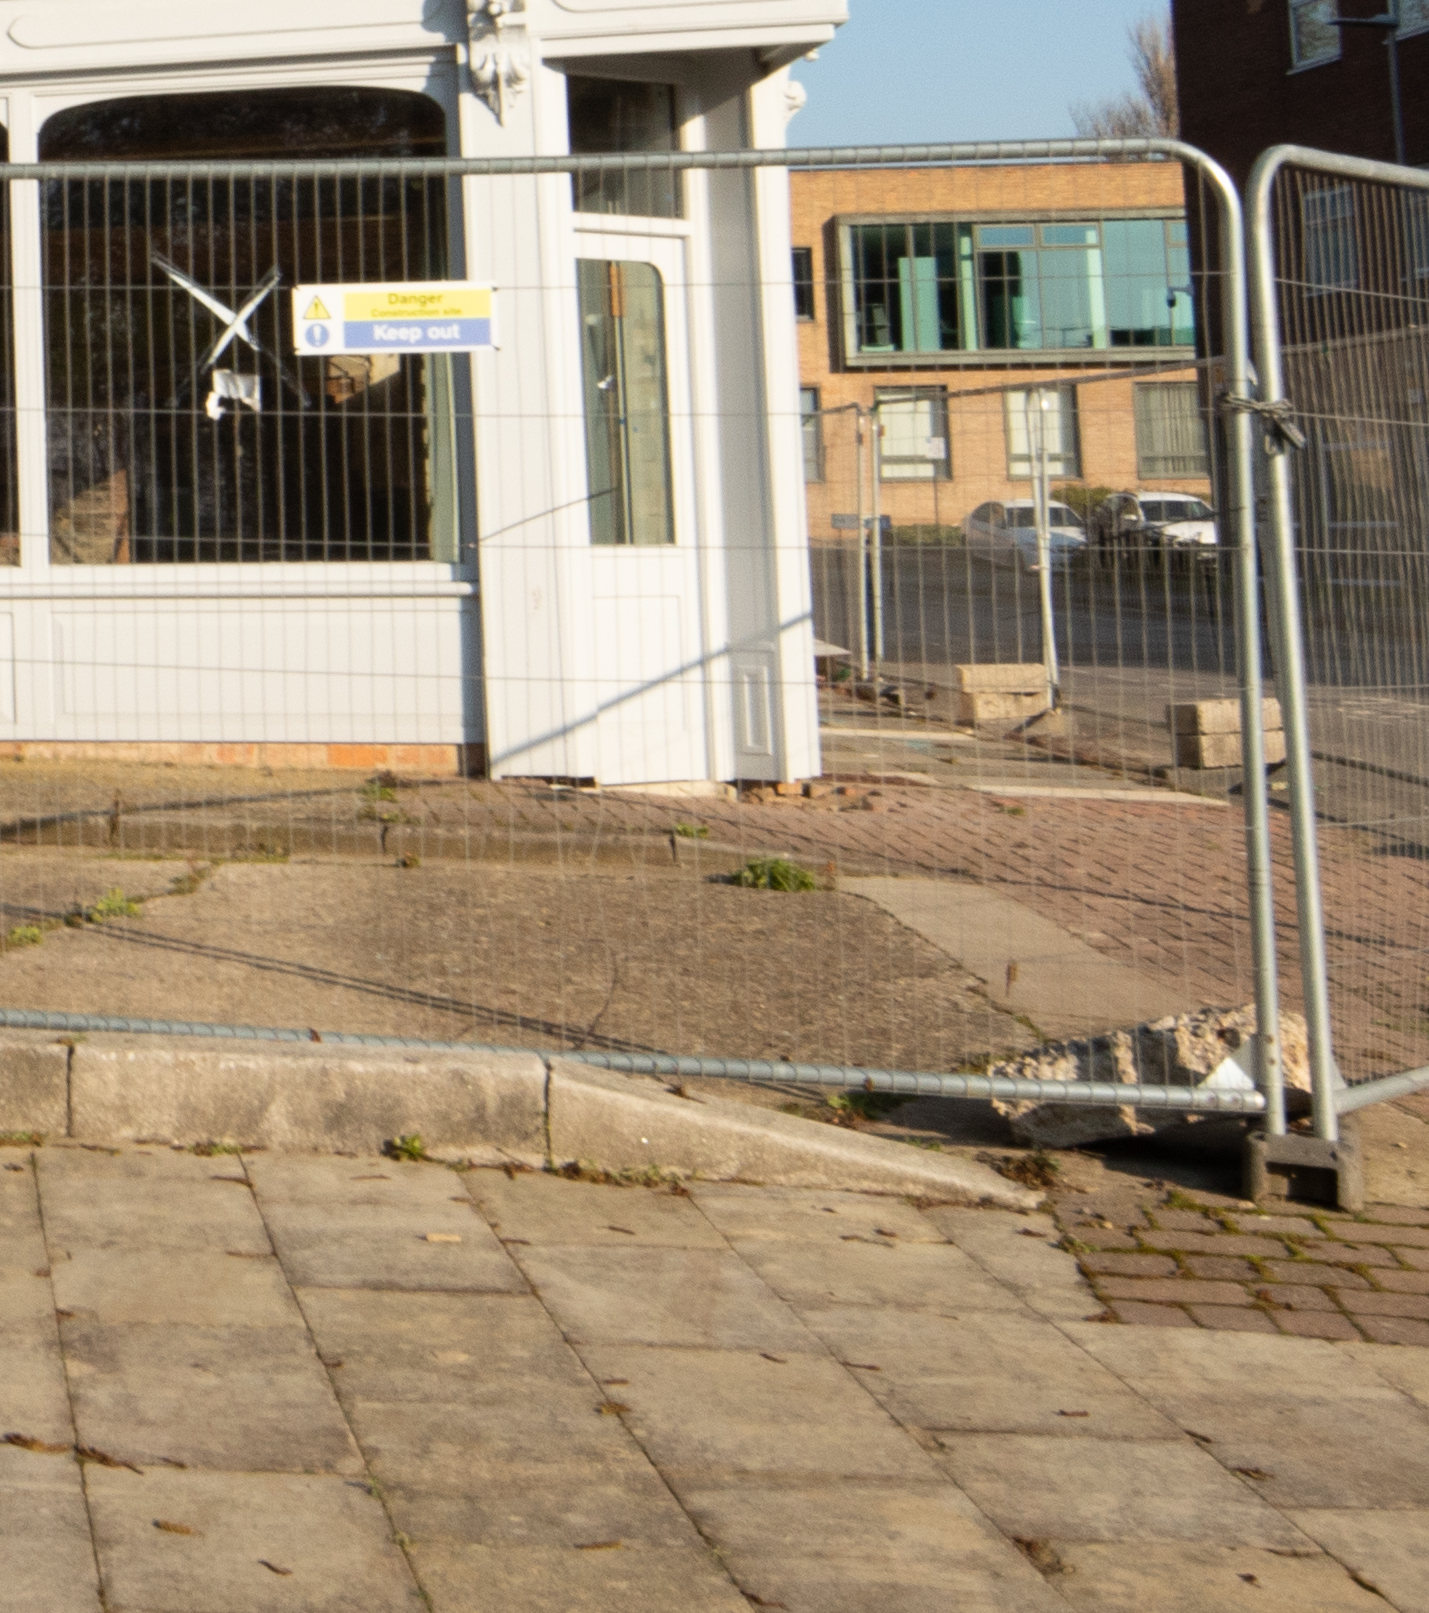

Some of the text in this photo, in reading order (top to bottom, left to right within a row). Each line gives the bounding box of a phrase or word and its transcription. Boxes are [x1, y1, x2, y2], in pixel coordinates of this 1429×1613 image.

[387, 292, 443, 307] Danger
[370, 307, 462, 318] Construction site
[372, 323, 461, 344] Keep out
